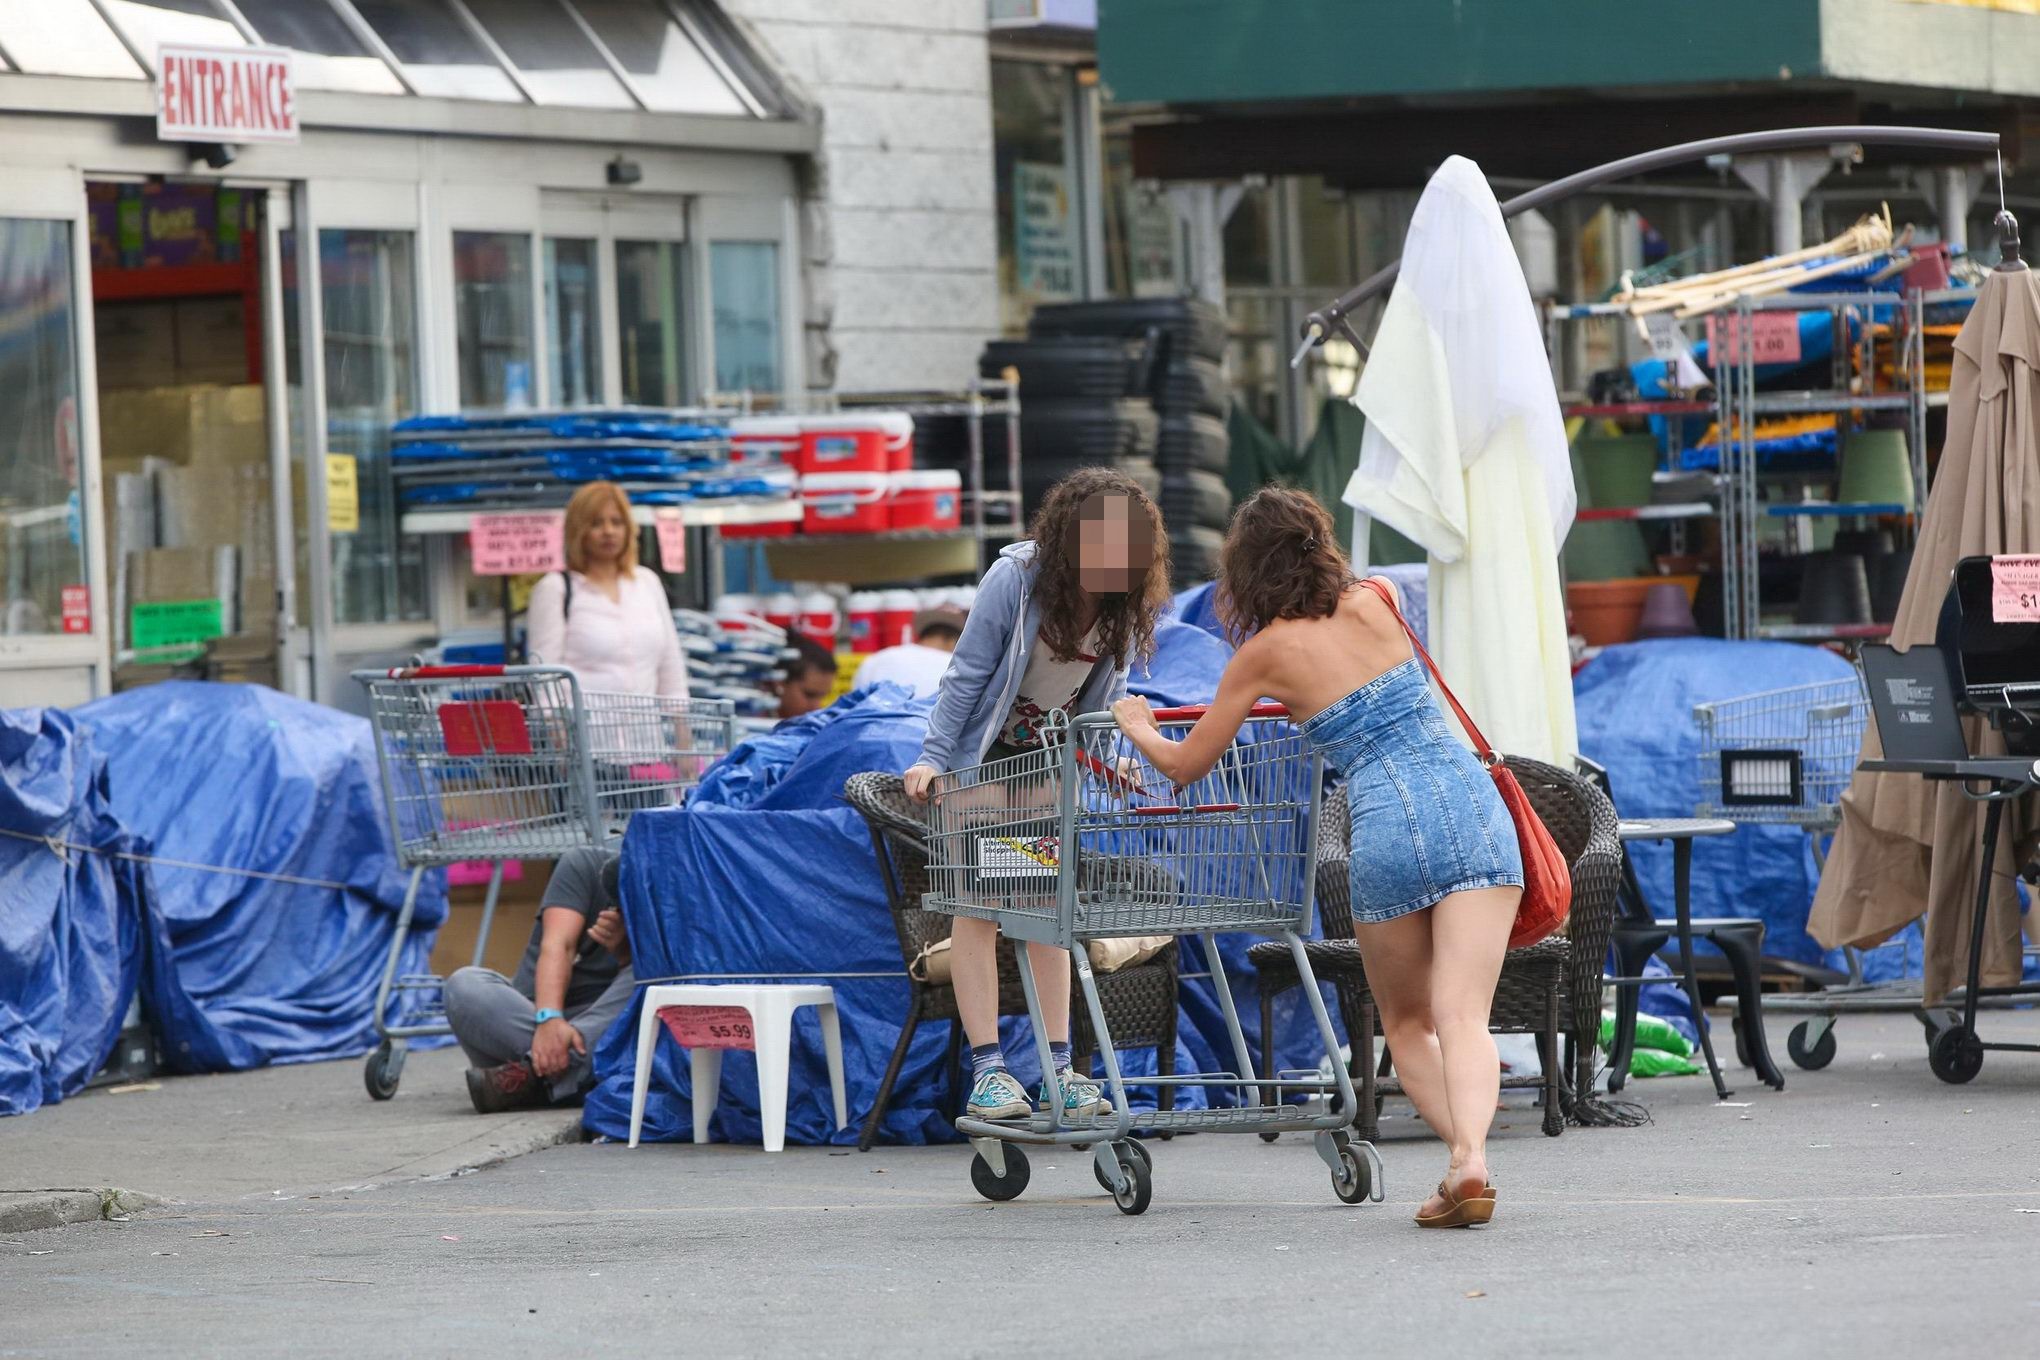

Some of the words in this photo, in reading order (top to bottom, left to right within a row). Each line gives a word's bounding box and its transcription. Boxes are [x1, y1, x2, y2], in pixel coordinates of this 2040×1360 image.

[164, 57, 291, 130] ENTRANCE
[983, 847, 1016, 855] Shoppes
[709, 1024, 751, 1039] $5.99
